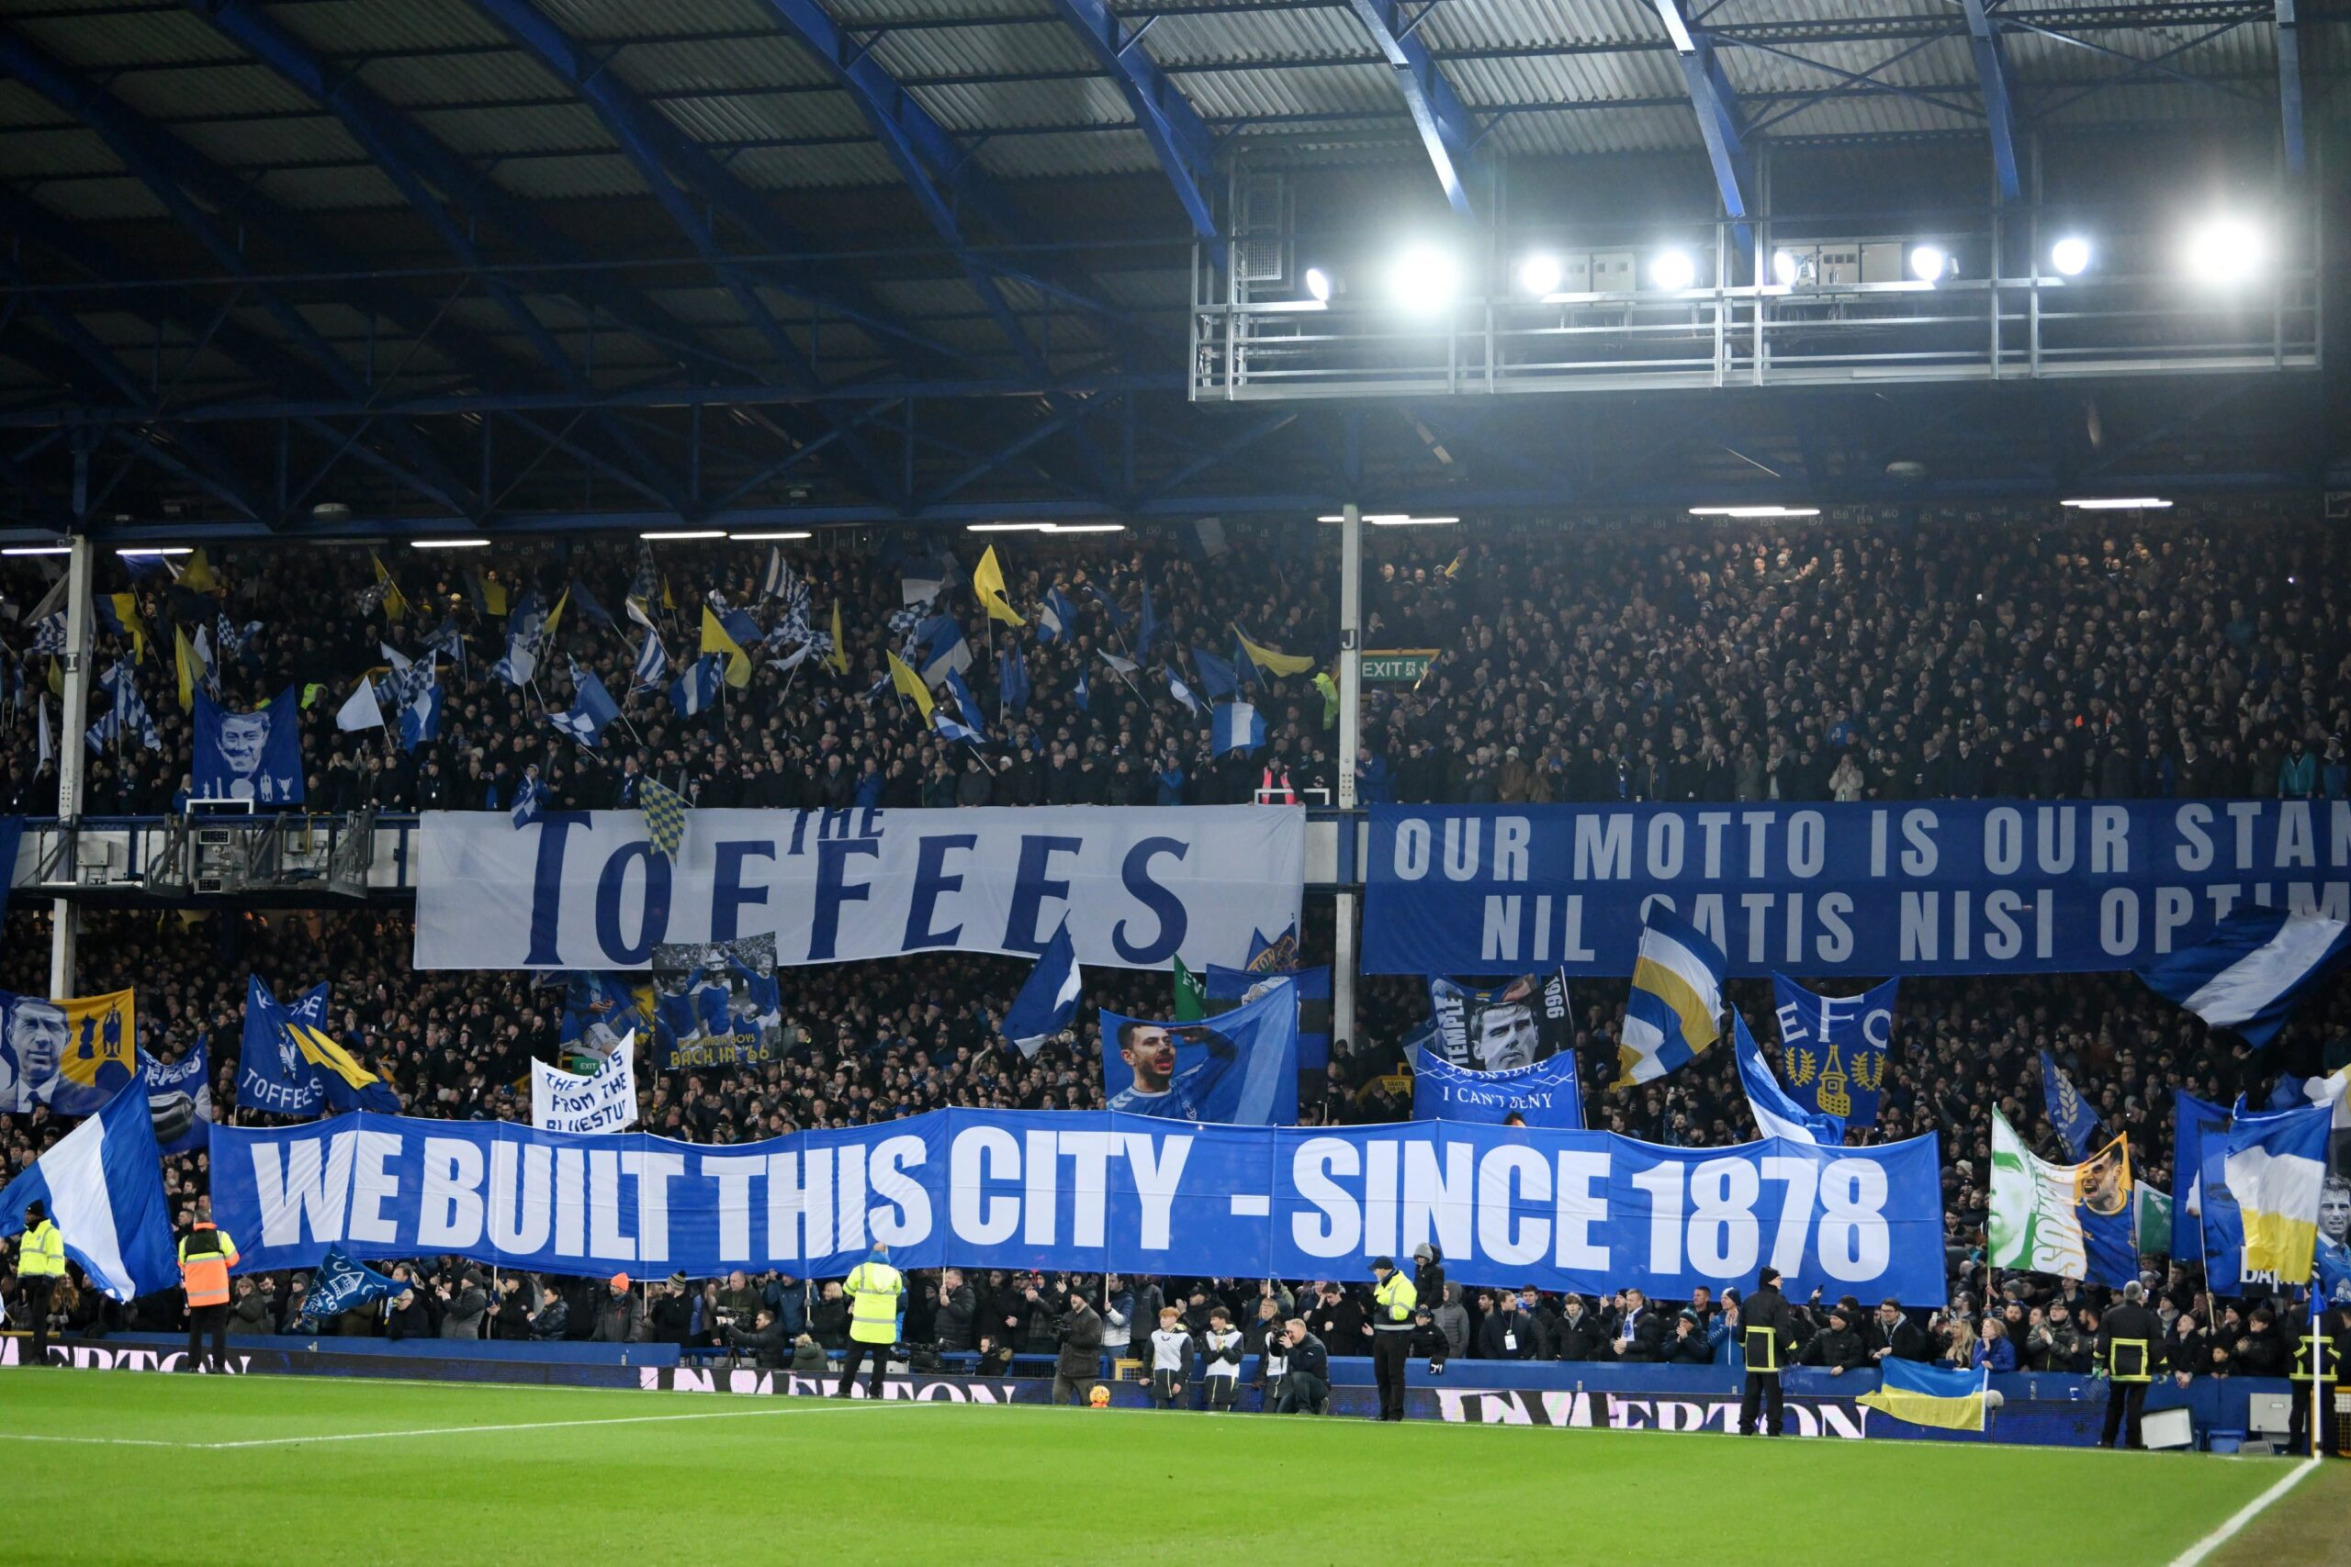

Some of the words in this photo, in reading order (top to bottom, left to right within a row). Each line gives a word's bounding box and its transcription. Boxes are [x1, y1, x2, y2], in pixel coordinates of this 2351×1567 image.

[1342, 630, 1355, 650] J
[1362, 661, 1402, 677] EXIT
[787, 807, 885, 855] THE
[1393, 816, 1532, 881] OUR
[1573, 810, 1825, 881] MOTTO
[1870, 808, 1939, 877] IS
[1984, 805, 2130, 876] OUR
[517, 811, 1189, 966] TOFFEES
[1481, 895, 1595, 962] NIL
[1900, 889, 2053, 962] NISI
[1544, 976, 1565, 1019] 1966
[1443, 997, 1469, 1065] TEMPLE
[1775, 993, 1892, 1049] EFC
[670, 1047, 714, 1067] BACK
[720, 1046, 735, 1063] IN
[242, 1068, 323, 1109] TOFFEES
[546, 1072, 579, 1092] THE
[552, 1092, 596, 1113] FROM
[601, 1072, 627, 1099] THE
[1443, 1086, 1449, 1101] I
[1457, 1087, 1505, 1108] CAN'T
[251, 1131, 403, 1248] WE
[417, 1137, 685, 1262] BUILT
[702, 1134, 933, 1261] THIS
[950, 1125, 1194, 1250] CITY
[1292, 1137, 1611, 1272] SINCE
[1632, 1156, 1890, 1282] 1878
